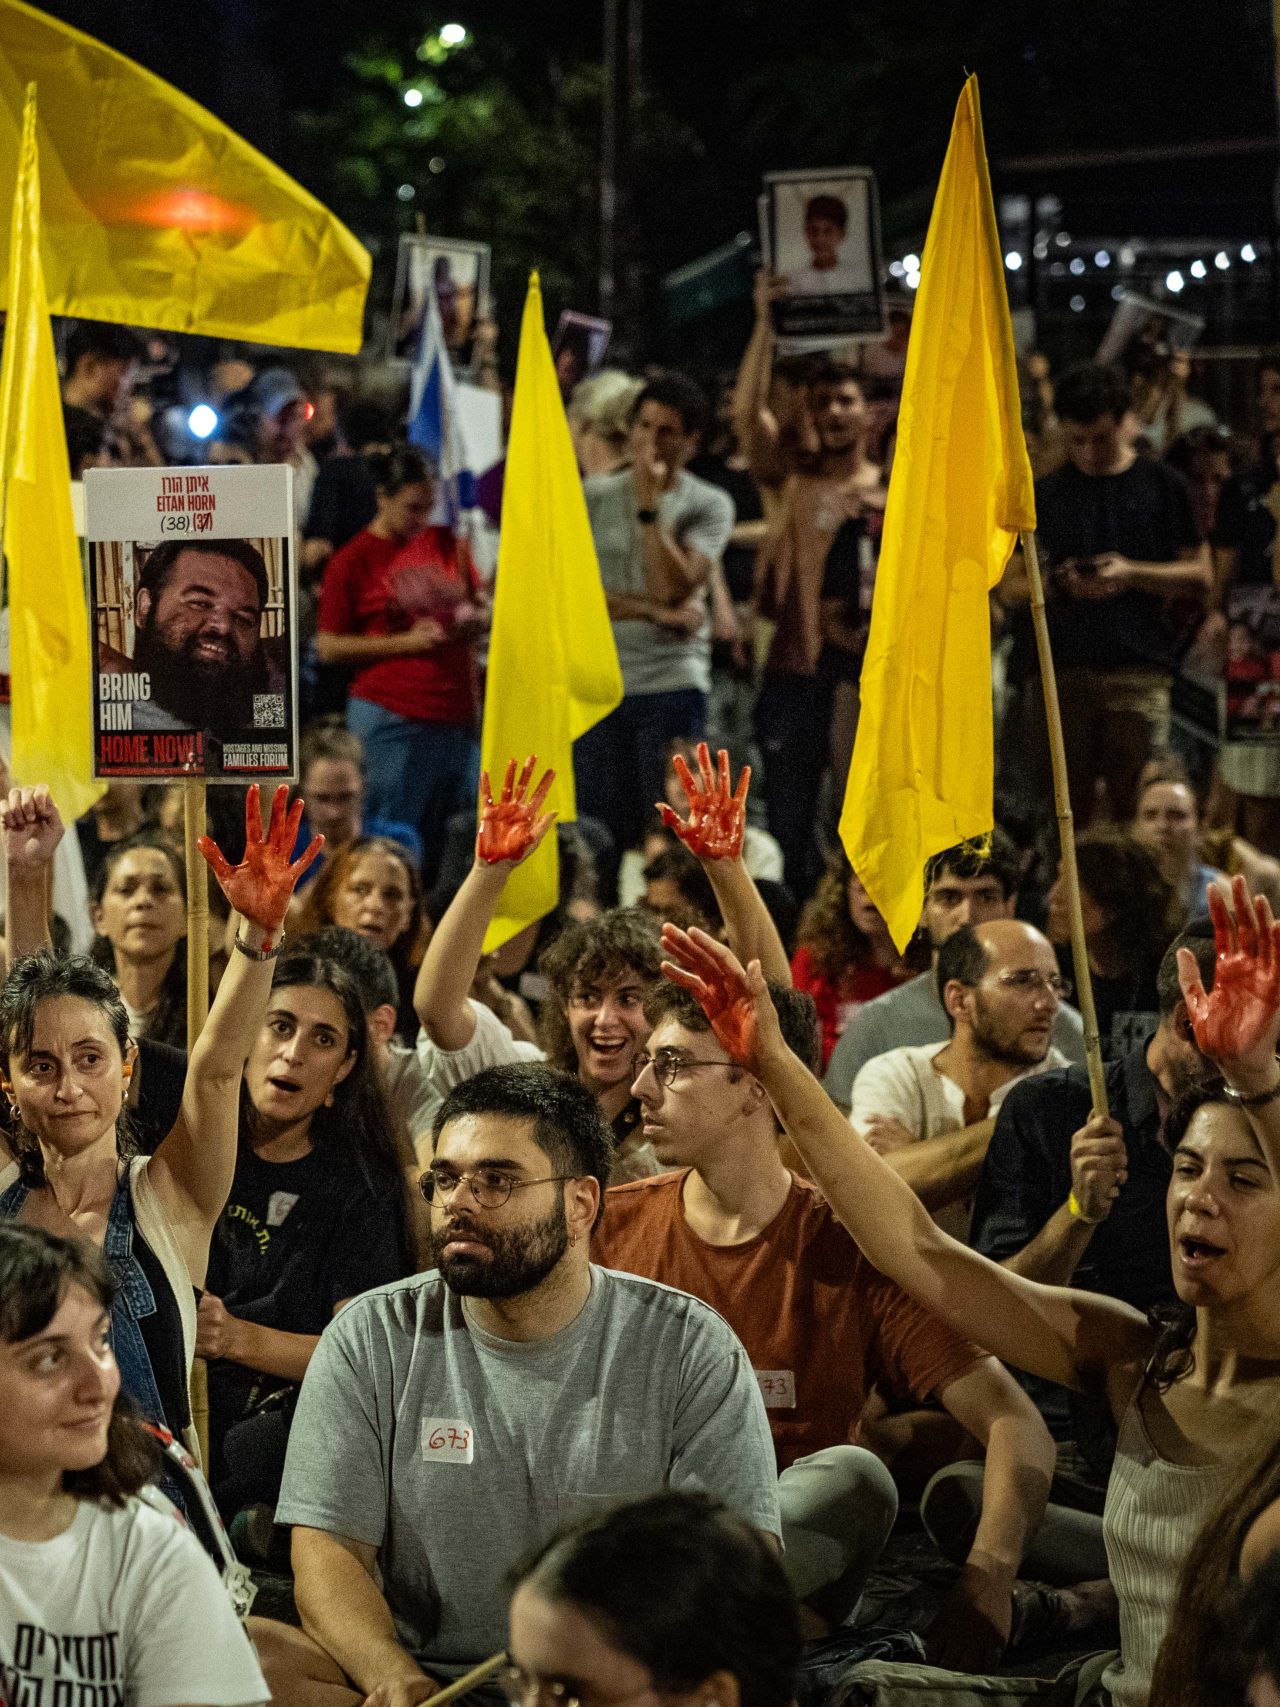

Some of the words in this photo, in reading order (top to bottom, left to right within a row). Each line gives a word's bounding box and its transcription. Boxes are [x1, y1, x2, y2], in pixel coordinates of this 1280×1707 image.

[161, 476, 182, 495] הורן
[185, 475, 209, 494] איתן
[157, 495, 184, 512] EITAN
[188, 494, 216, 511] HORN
[161, 515, 190, 533] (38)
[99, 672, 151, 701] BRING
[100, 703, 132, 731] HIM
[100, 735, 150, 763] HOME
[153, 731, 204, 763] NOW!
[223, 743, 251, 753] HOSTAGES
[252, 743, 262, 753] AND
[263, 743, 288, 753] MISSING
[223, 753, 258, 766] FAMILIES
[260, 753, 288, 766] FORUM
[758, 1377, 787, 1394] 73
[428, 1427, 470, 1449] 673
